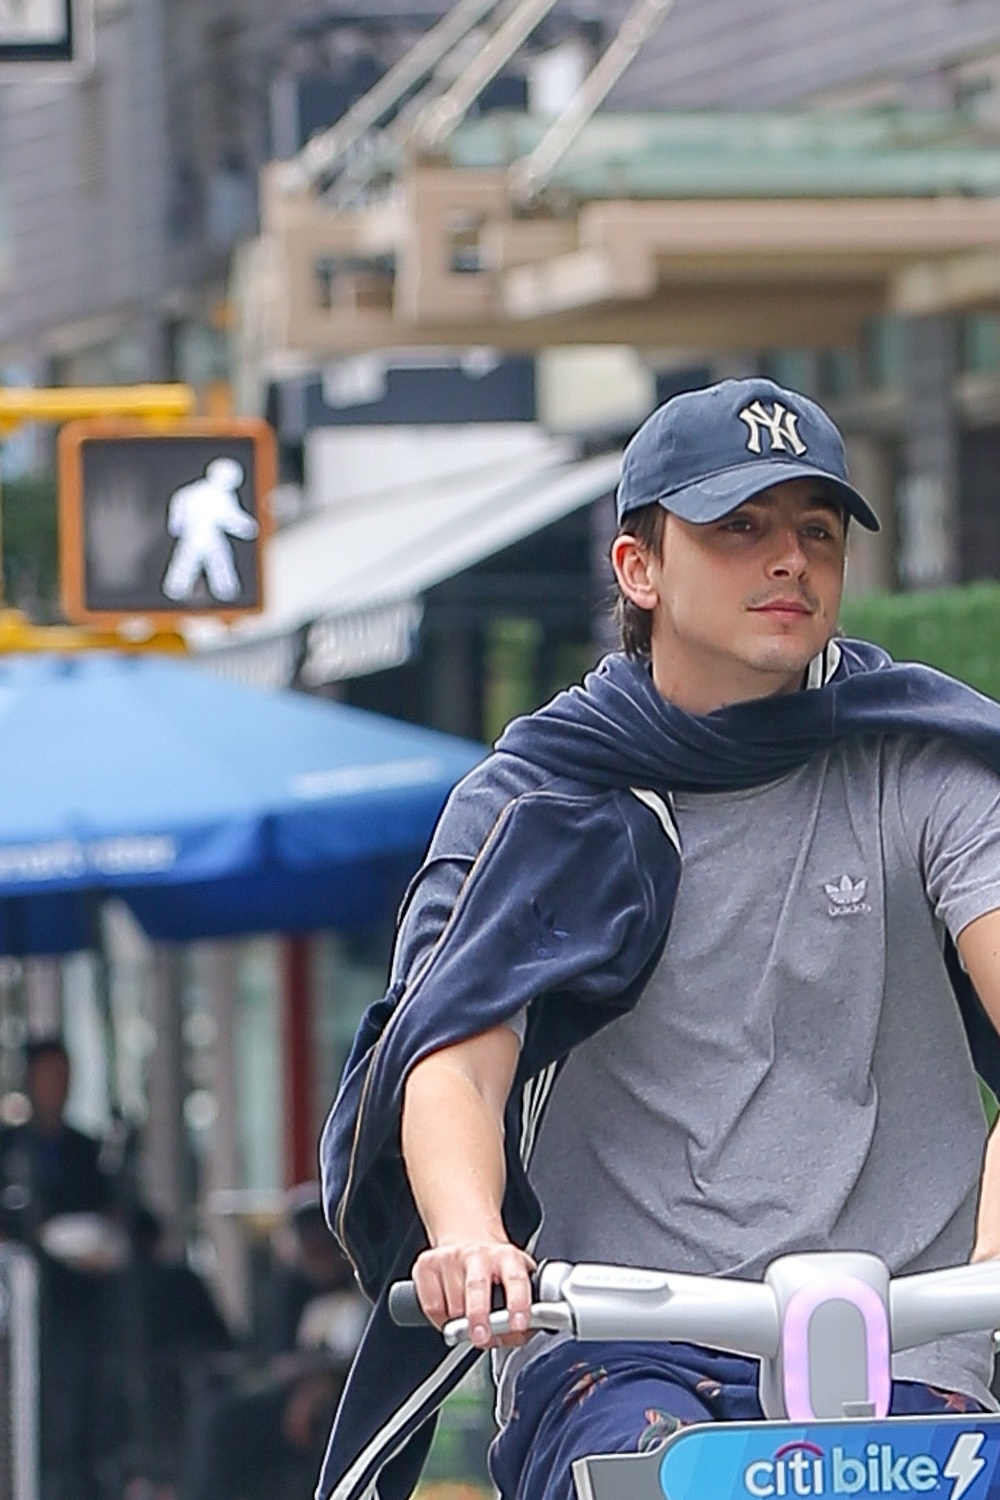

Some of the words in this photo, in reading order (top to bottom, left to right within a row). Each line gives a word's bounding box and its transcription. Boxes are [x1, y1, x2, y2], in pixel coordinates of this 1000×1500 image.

[739, 400, 807, 455] NY
[745, 1441, 824, 1497] citi
[832, 1444, 938, 1493] bike
